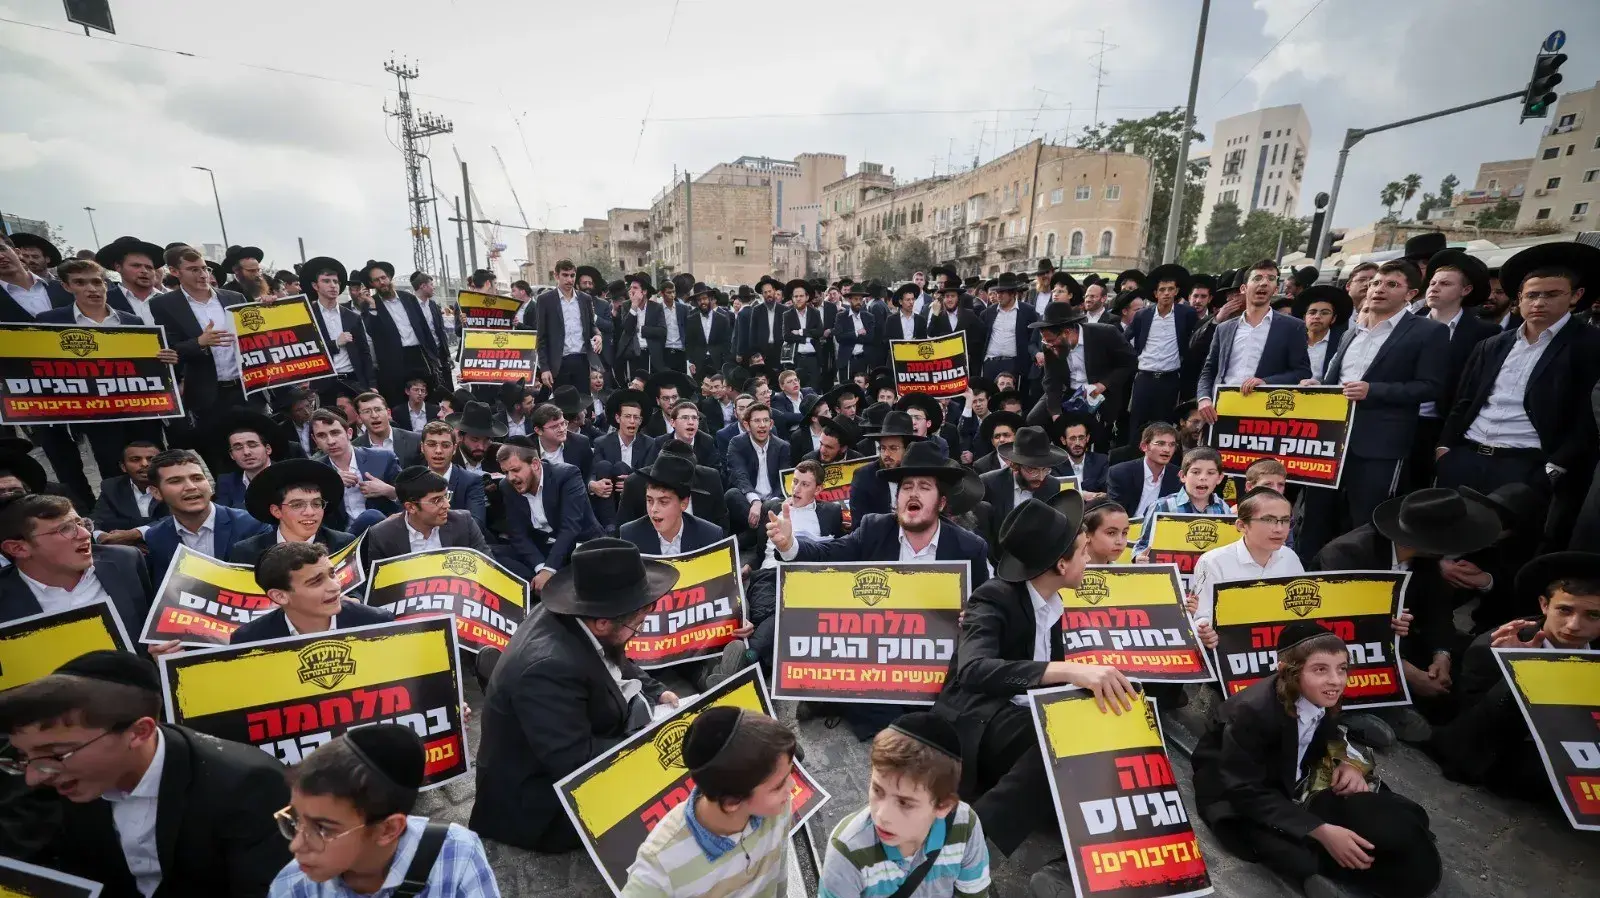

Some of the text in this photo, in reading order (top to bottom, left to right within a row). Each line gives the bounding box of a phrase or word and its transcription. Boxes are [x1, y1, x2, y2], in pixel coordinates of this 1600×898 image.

[487, 318, 510, 327] בחוק
[240, 329, 298, 351] מלחמ
[269, 340, 320, 364] בחוק
[477, 349, 520, 358] מלחמה
[31, 359, 136, 376] מלחמה
[266, 366, 285, 377] ולא
[286, 358, 325, 372] במעשים
[464, 358, 530, 369] בחוק הגיוס
[907, 359, 953, 372] מלחמה
[898, 366, 966, 384] בחוק הגיוס
[5, 376, 165, 396] בחוק הגיוס
[940, 380, 967, 391] במעשים
[11, 396, 168, 410] במעשים ולא בדיבורים!
[1238, 419, 1319, 438] מלחמה
[1218, 433, 1336, 457] בחוק הגיוס
[1288, 460, 1332, 473] במעשים
[405, 578, 500, 611] מלחמה
[668, 597, 733, 634] בחוק
[817, 610, 926, 635] מלחמה
[1062, 607, 1151, 630] מלחמ
[456, 619, 469, 633] ול
[681, 624, 734, 645] במעשים
[654, 638, 676, 651] ולא
[789, 636, 868, 659] הגיוס
[1109, 628, 1186, 650] בחוק
[1102, 653, 1128, 665] ולא
[1132, 654, 1194, 666] במעשים
[787, 665, 948, 684] מעשים ולא בדיבורים!
[247, 686, 411, 741] מלחמה
[1079, 790, 1188, 835] הגיוס
[1092, 842, 1190, 874] בדיבורים!
